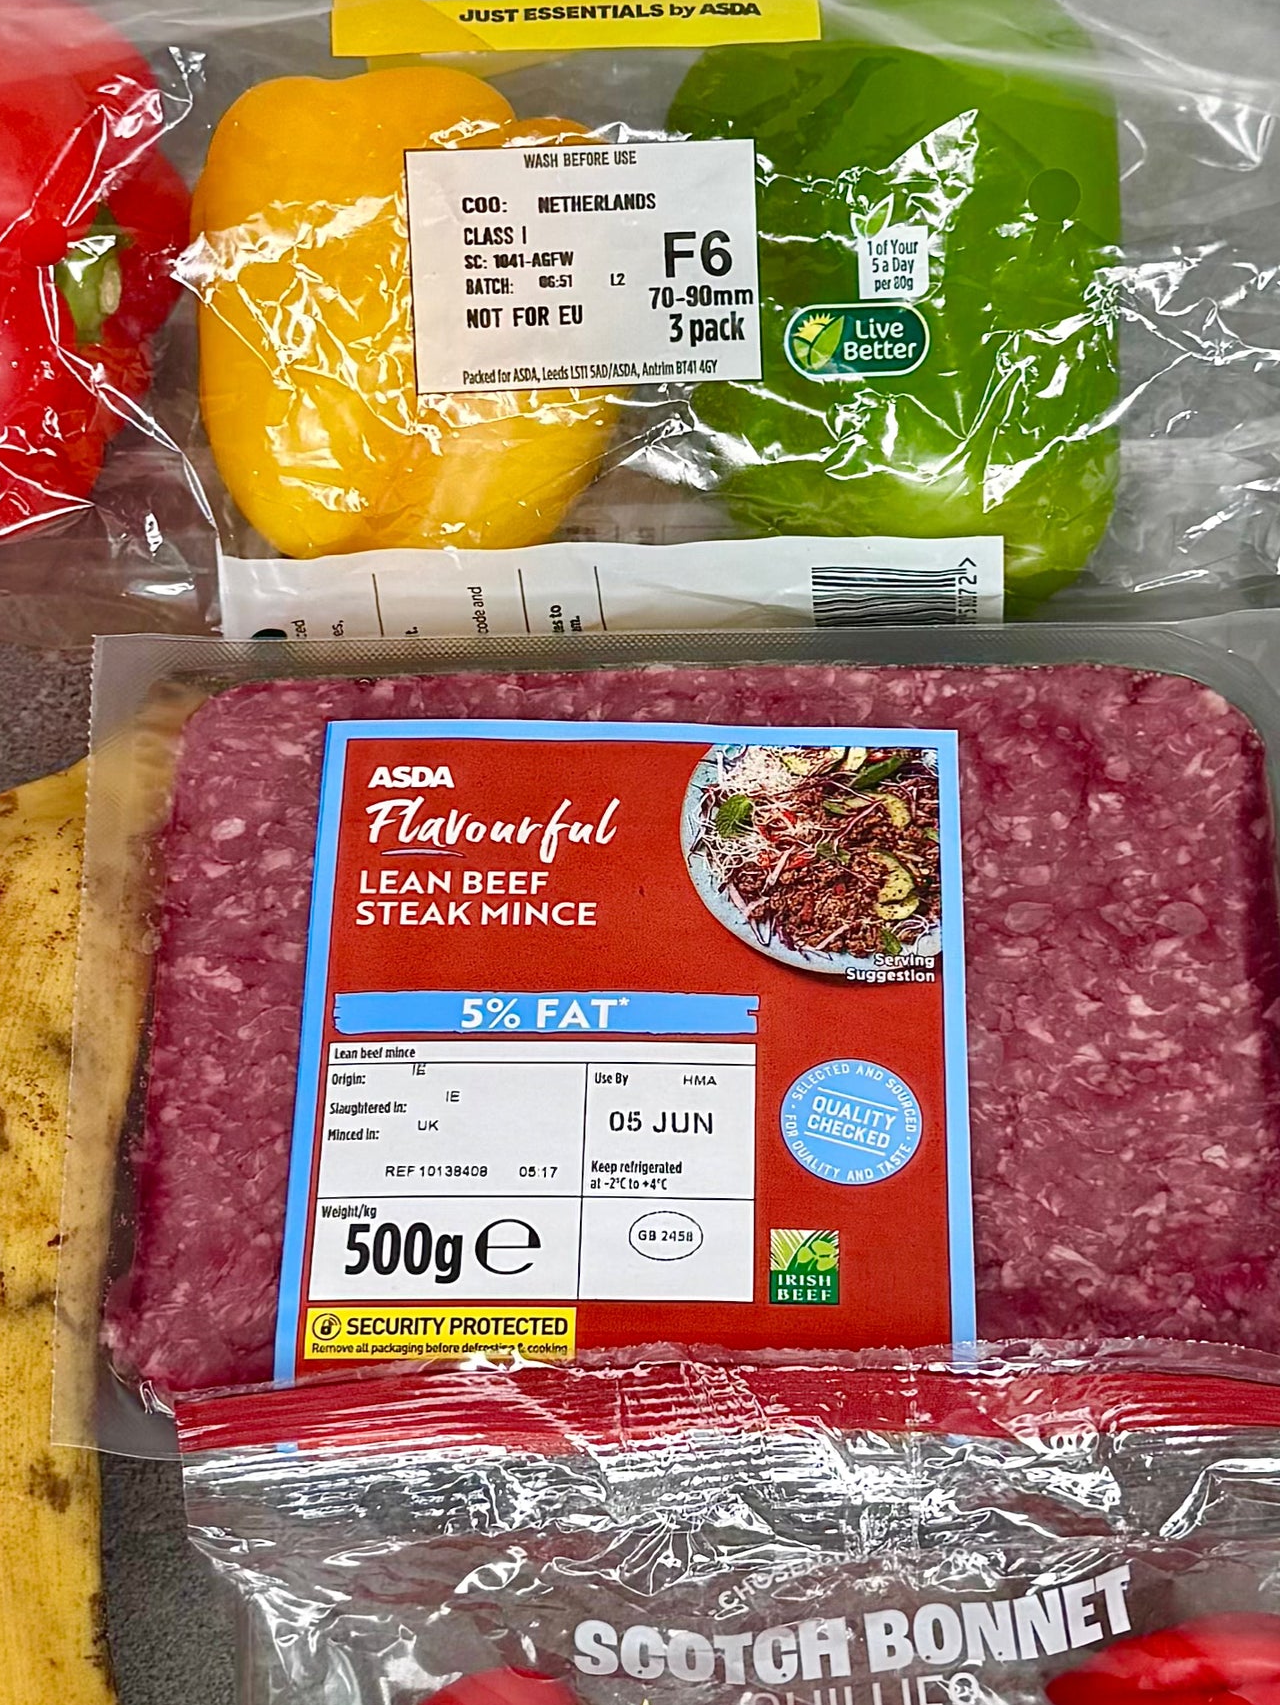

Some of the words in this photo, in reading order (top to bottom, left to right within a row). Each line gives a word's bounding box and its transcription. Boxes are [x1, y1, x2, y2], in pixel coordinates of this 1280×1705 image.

[460, 7, 518, 24] JUST
[524, 3, 664, 21] ESSENTIALS
[669, 3, 695, 19] by
[700, 2, 761, 16] ASDA
[524, 153, 558, 168] WASH
[564, 152, 610, 167] BEFORE
[614, 151, 636, 165] USE
[462, 197, 507, 213] COO:
[538, 194, 656, 212] NETHERLANDS
[464, 227, 513, 245] CLASS
[664, 229, 733, 278] F6
[876, 241, 888, 255] of
[890, 240, 918, 255] Your
[465, 255, 487, 269] SC:
[873, 259, 879, 273] 5
[893, 258, 914, 275] Day
[466, 278, 513, 294] BATCH:
[611, 274, 625, 286] L2
[875, 279, 890, 292] per
[894, 276, 913, 291] 80g
[649, 286, 753, 309] 70-90mm
[467, 308, 504, 328] NOT
[513, 307, 549, 326] FOR
[559, 306, 583, 325] EU
[670, 314, 683, 342] 3
[690, 311, 744, 346] pack
[856, 319, 904, 339] Live
[844, 341, 916, 360] Better
[463, 370, 496, 384] Packed
[498, 368, 511, 382] for
[513, 367, 540, 383] ASDA,
[542, 366, 568, 381] Leeds
[590, 362, 640, 379] 5AD/ASDA,
[642, 361, 673, 377] Antrim
[676, 360, 696, 374] BT41
[699, 360, 717, 374] 4GY
[368, 766, 454, 788] ASDA
[365, 796, 620, 863] Flavourful
[360, 870, 451, 894] LEAN
[462, 871, 549, 894] BEEF
[356, 901, 472, 925] STEAK
[481, 901, 597, 925] MINCE
[874, 953, 935, 968] Serving
[846, 968, 935, 983] Suggestion
[461, 998, 521, 1029] 5%
[335, 1048, 357, 1059] Lean
[361, 1047, 382, 1059] beef
[385, 1047, 415, 1058] mince
[331, 1073, 365, 1087] Origin:
[595, 1072, 612, 1084] Use
[616, 1073, 628, 1086] By
[683, 1075, 717, 1085] HMA
[330, 1102, 391, 1116] Slaughtered
[446, 1091, 460, 1102] IE
[791, 1063, 850, 1101] SELECTED
[855, 1066, 884, 1082] AND
[885, 1077, 917, 1133] SOURCED
[610, 1111, 642, 1132] 05
[653, 1111, 713, 1134] JUN
[812, 1096, 897, 1131] QUALITY
[328, 1128, 363, 1141] Minced
[418, 1121, 439, 1131] UK
[807, 1116, 891, 1148] CHECKED
[784, 1113, 797, 1138] FOR
[792, 1140, 842, 1179] QUALITY
[847, 1168, 875, 1181] AND
[876, 1142, 913, 1176] TASTE
[385, 1166, 415, 1177] REF
[420, 1166, 488, 1177] 10138408
[519, 1167, 558, 1178] 05:17
[592, 1161, 617, 1173] Keep
[620, 1161, 682, 1174] refrigerated
[590, 1178, 601, 1189] at
[628, 1178, 639, 1189] to
[321, 1205, 377, 1218] Weight/kg
[638, 1231, 656, 1241] GB
[344, 1222, 463, 1284] 500g
[778, 1274, 831, 1287] IRISH
[777, 1288, 831, 1301] BEEF
[346, 1317, 445, 1335] SECURITY
[450, 1317, 568, 1335] PROTECTED
[312, 1343, 353, 1353] Remove
[355, 1343, 369, 1353] all
[370, 1342, 424, 1355] packaging
[426, 1342, 459, 1353] before
[527, 1344, 568, 1355] cooking
[573, 1609, 858, 1686] SCOTCH
[867, 1565, 1133, 1673] BONNET
